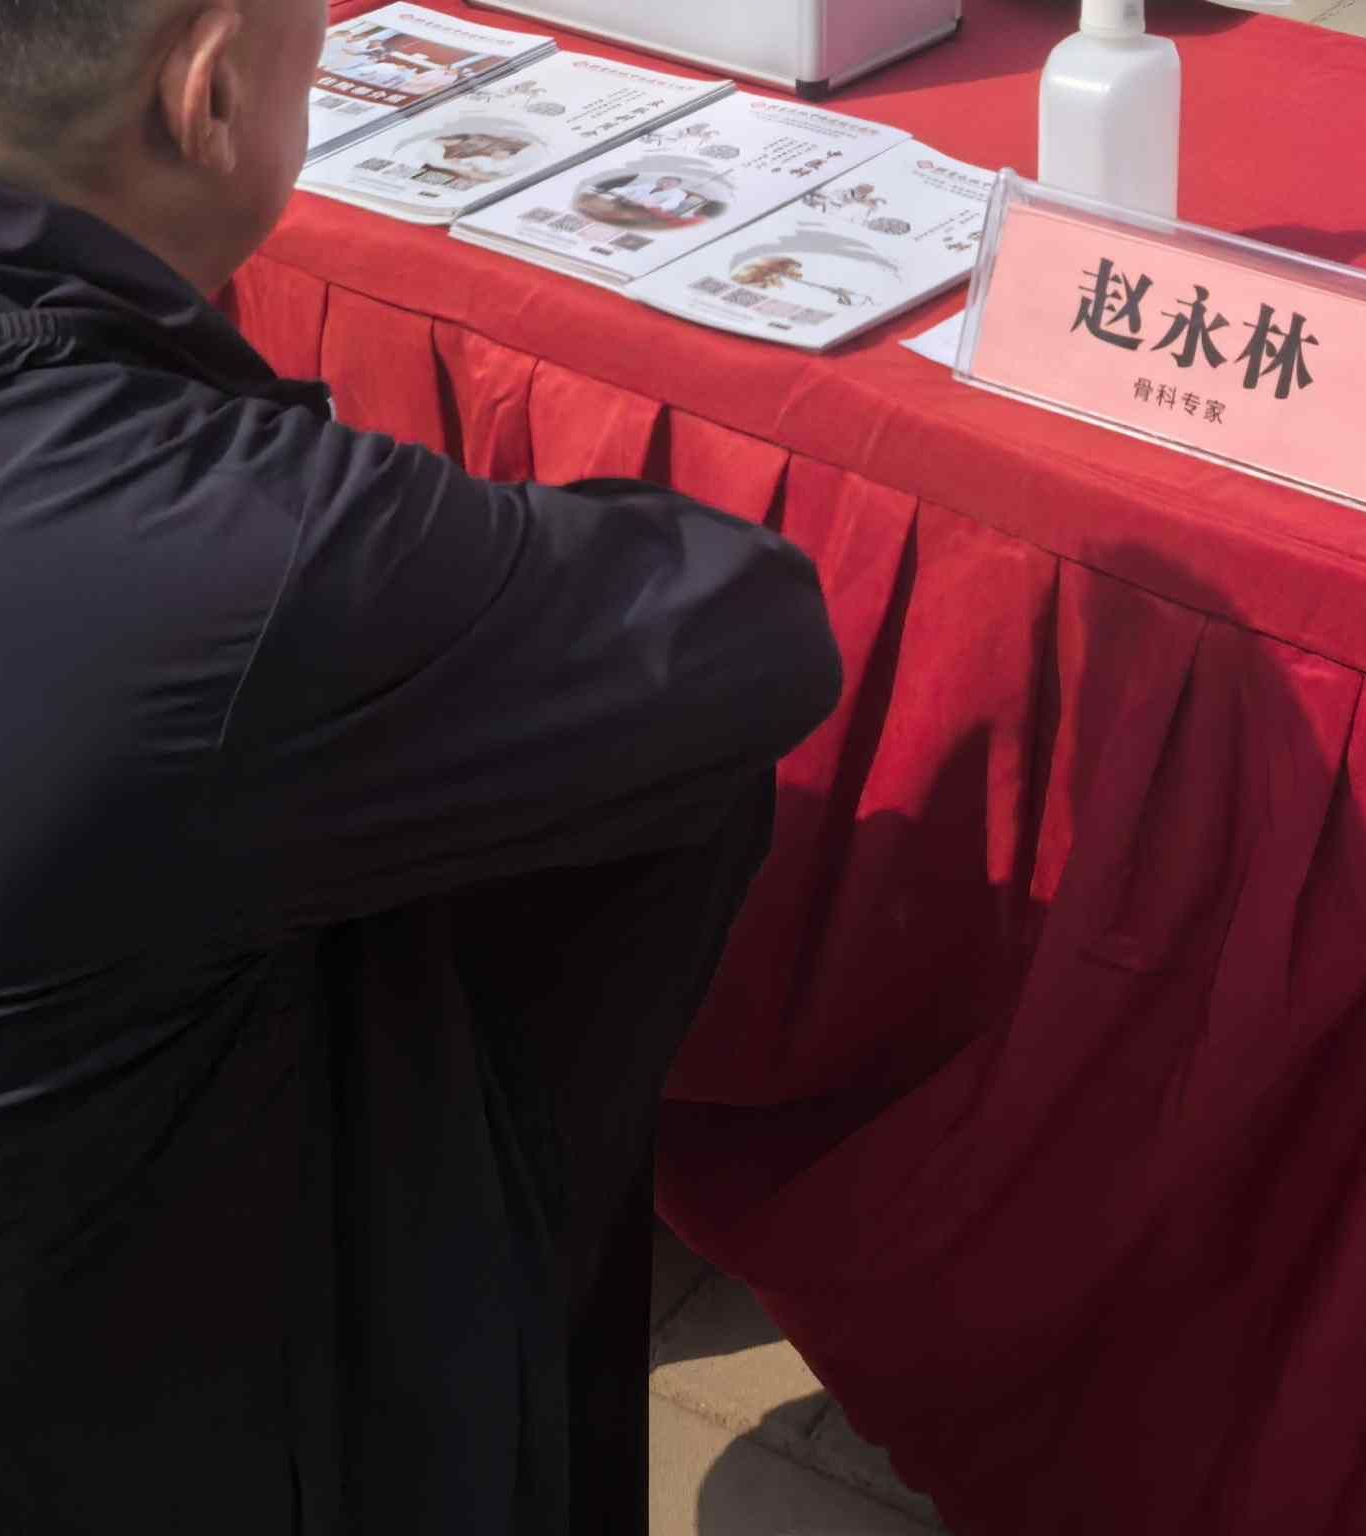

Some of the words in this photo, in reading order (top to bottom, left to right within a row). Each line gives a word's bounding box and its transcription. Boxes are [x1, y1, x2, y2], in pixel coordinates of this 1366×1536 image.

[1069, 257, 1321, 401] 赵永林
[1132, 377, 1228, 425] 骨科专家
